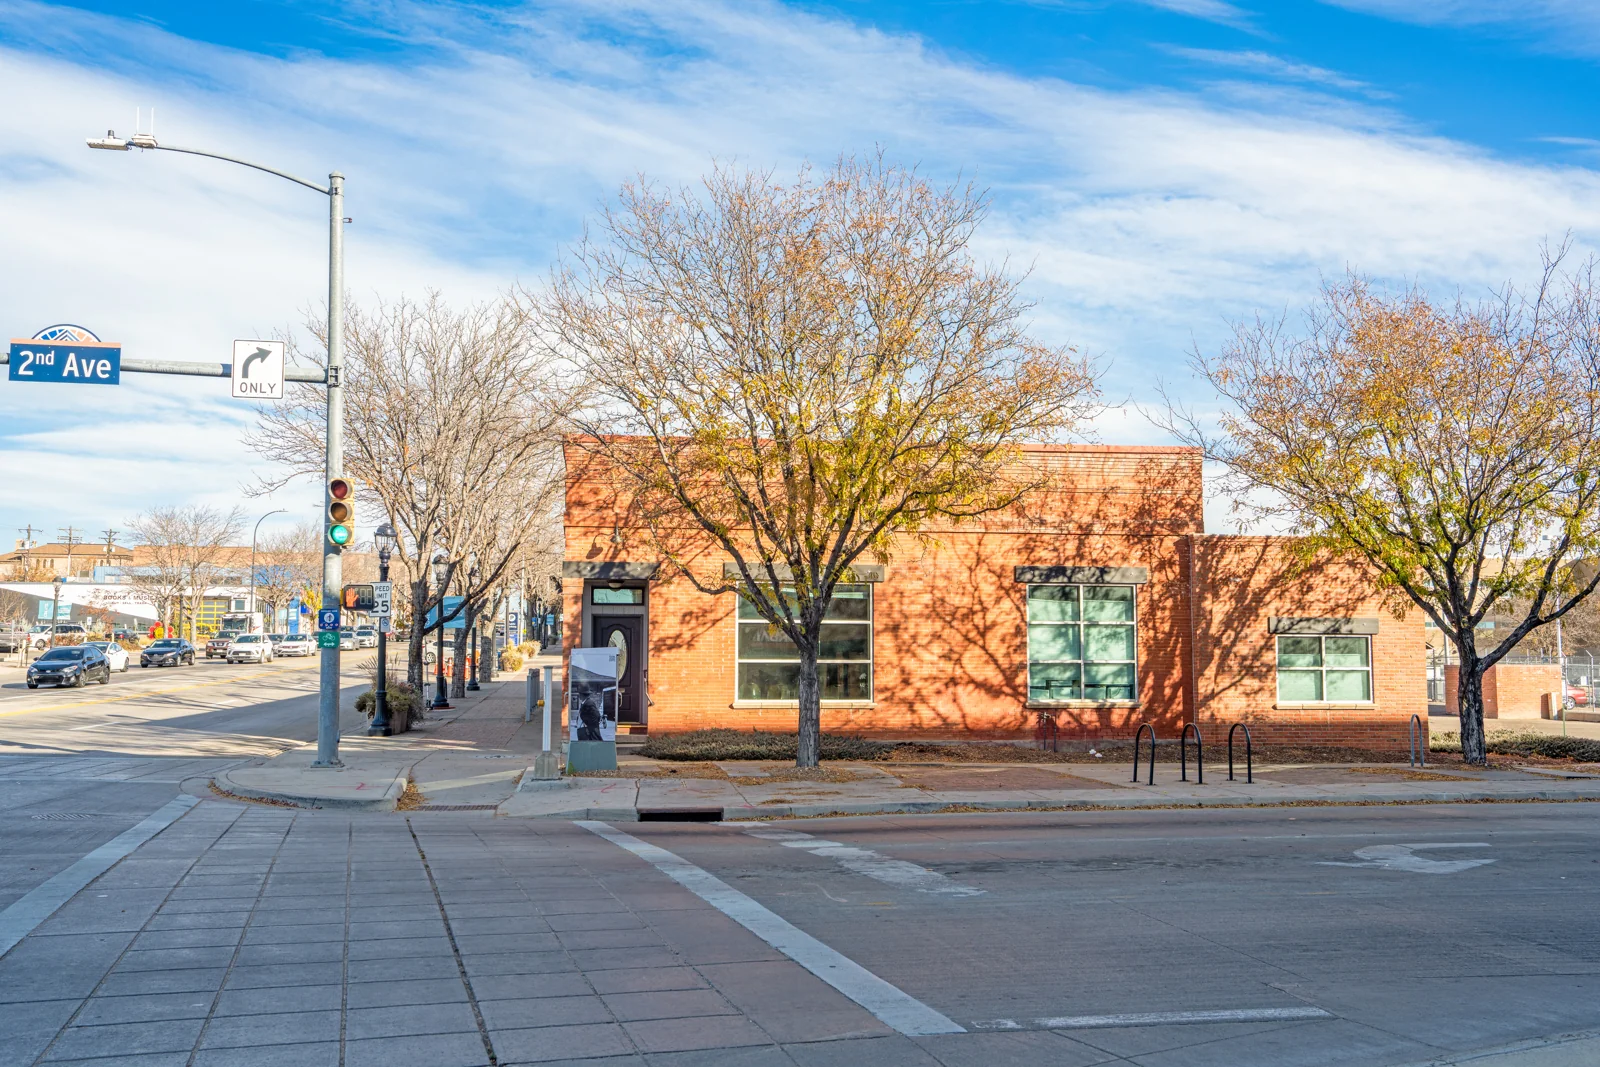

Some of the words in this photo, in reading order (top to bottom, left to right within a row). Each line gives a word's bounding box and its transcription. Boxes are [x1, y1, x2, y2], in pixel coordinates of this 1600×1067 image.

[18, 350, 55, 375] 2nd
[62, 353, 111, 378] Ave
[240, 382, 276, 393] ONLY
[371, 600, 389, 613] 25
